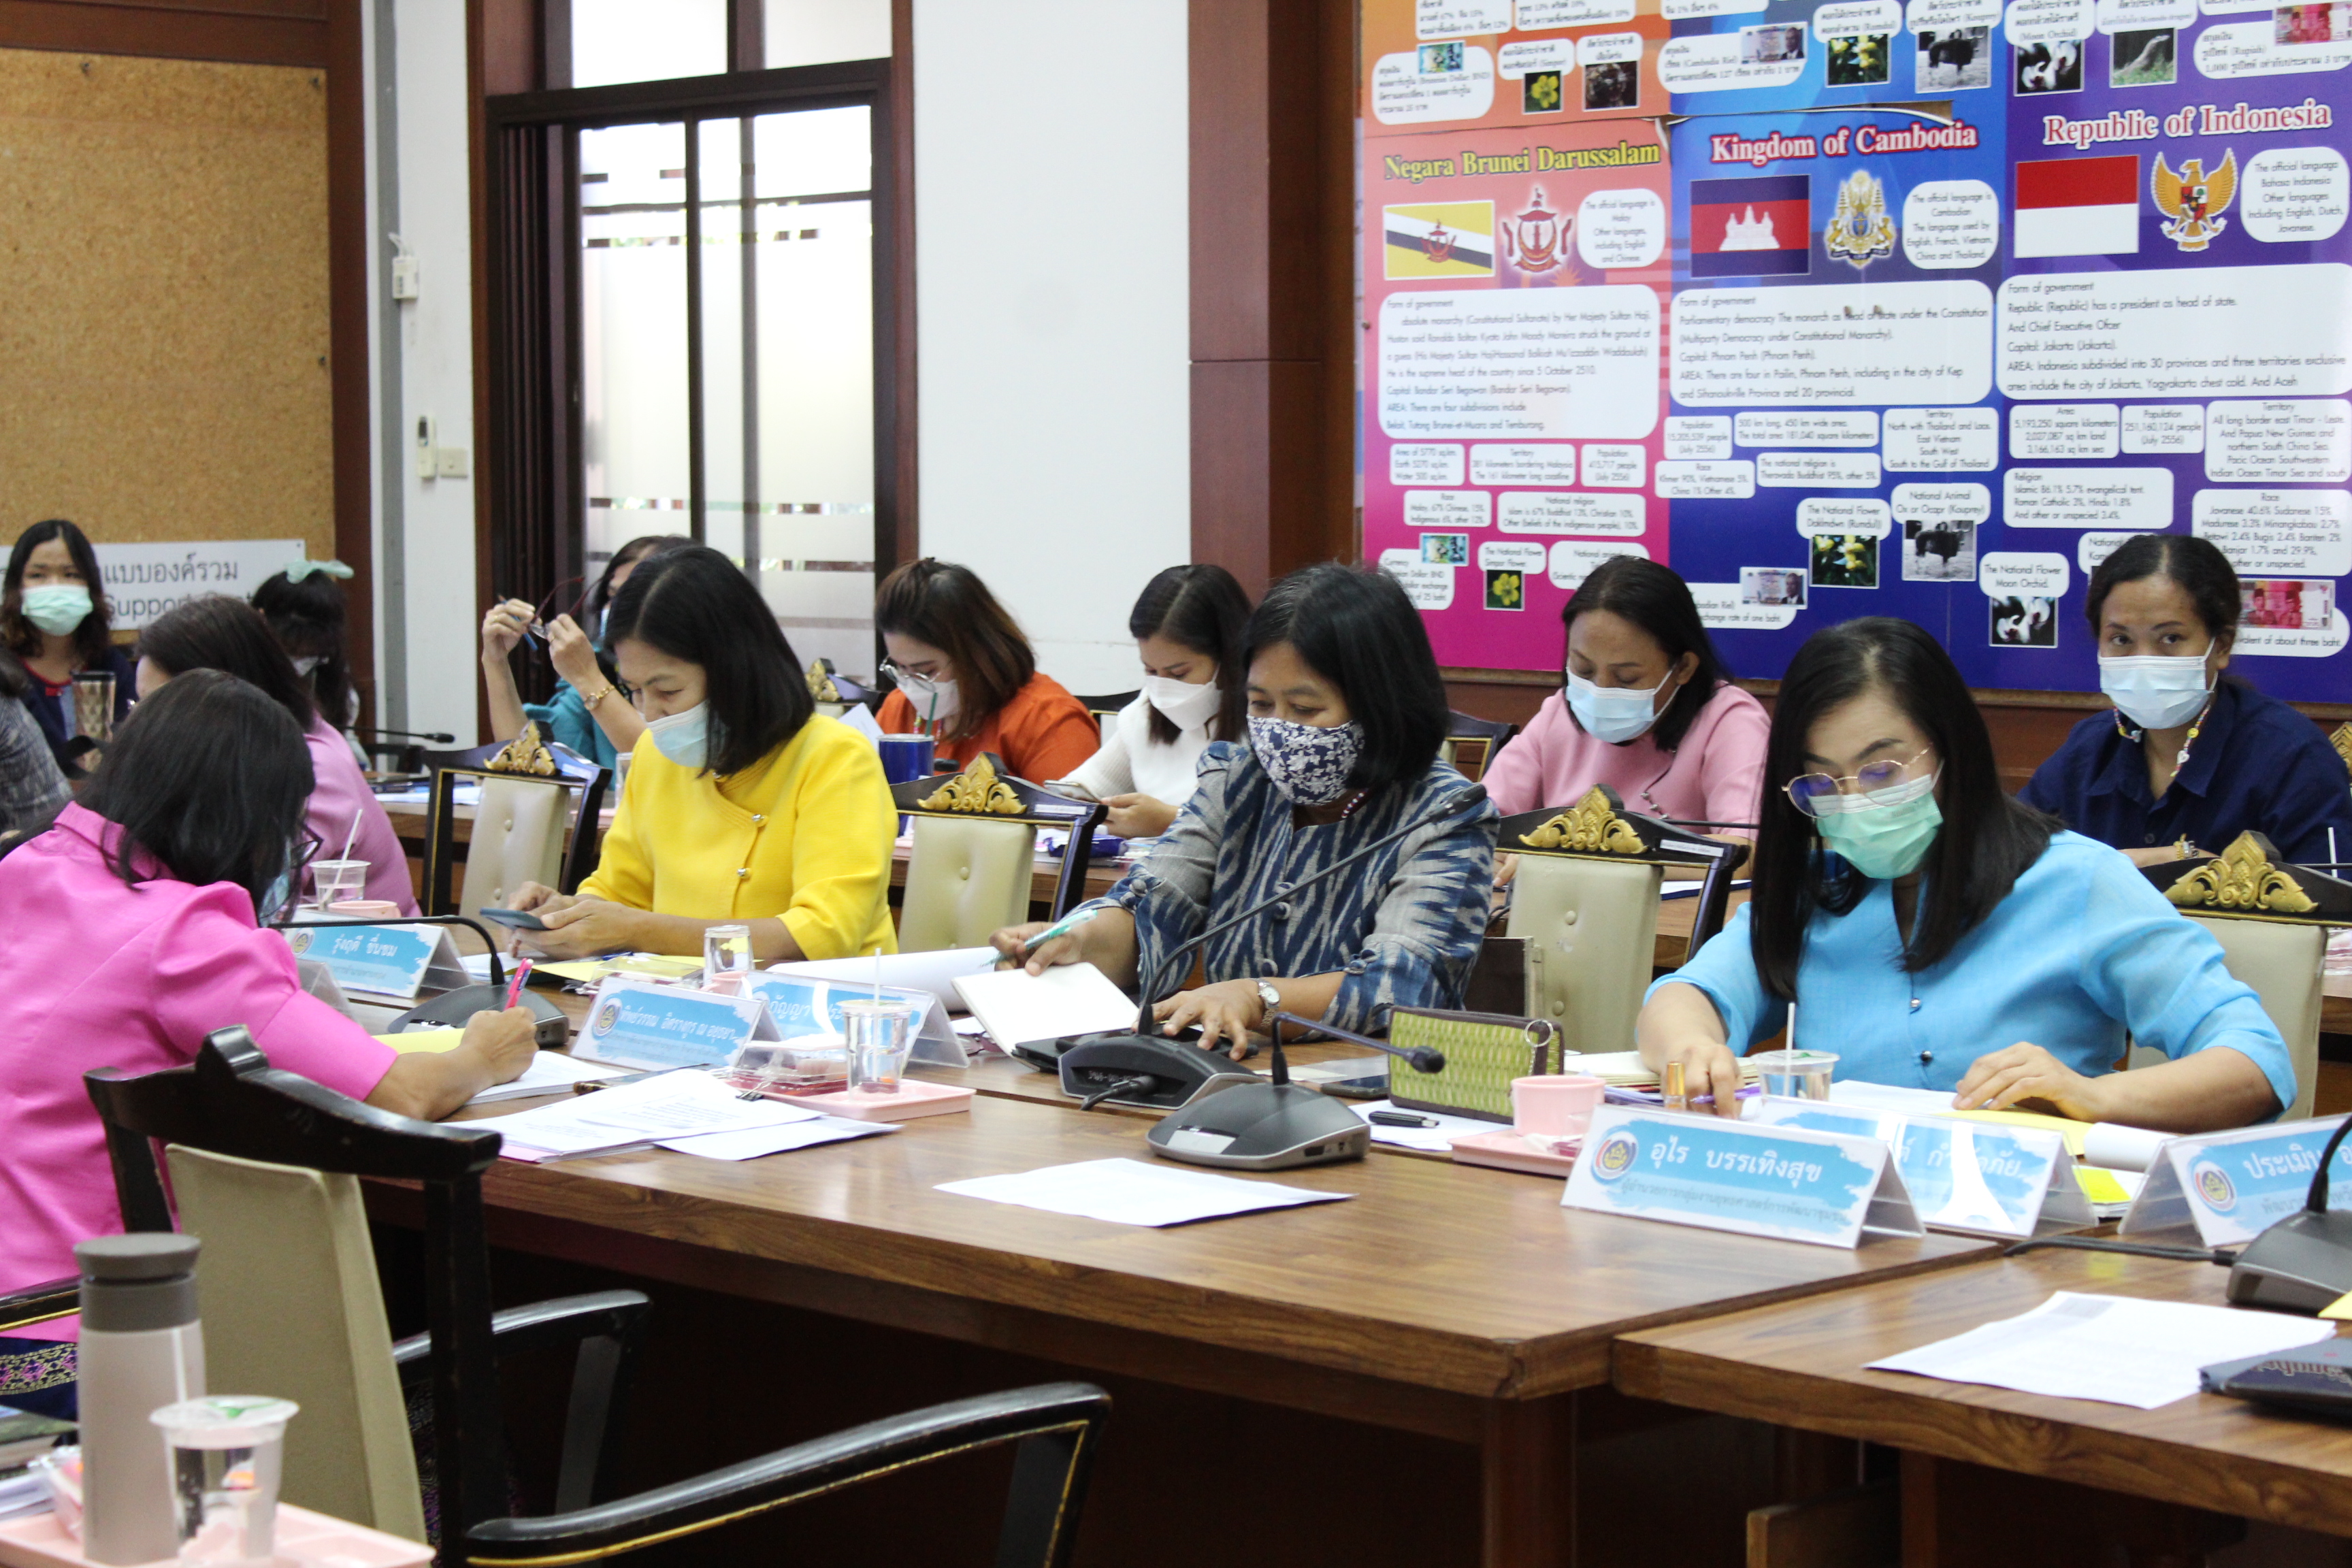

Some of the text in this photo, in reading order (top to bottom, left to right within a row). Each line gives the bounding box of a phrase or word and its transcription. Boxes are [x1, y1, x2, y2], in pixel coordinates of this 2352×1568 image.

[1712, 122, 1978, 166] Kingdom of Cambodia
[2044, 98, 2332, 148] Republic of Indonesia
[1384, 141, 1661, 183] Negara Brunei Darussalam
[2008, 282, 2029, 292] Form
[2044, 282, 2095, 295] government
[1650, 1135, 1823, 1188] อุไร บรรเทิงสุข
